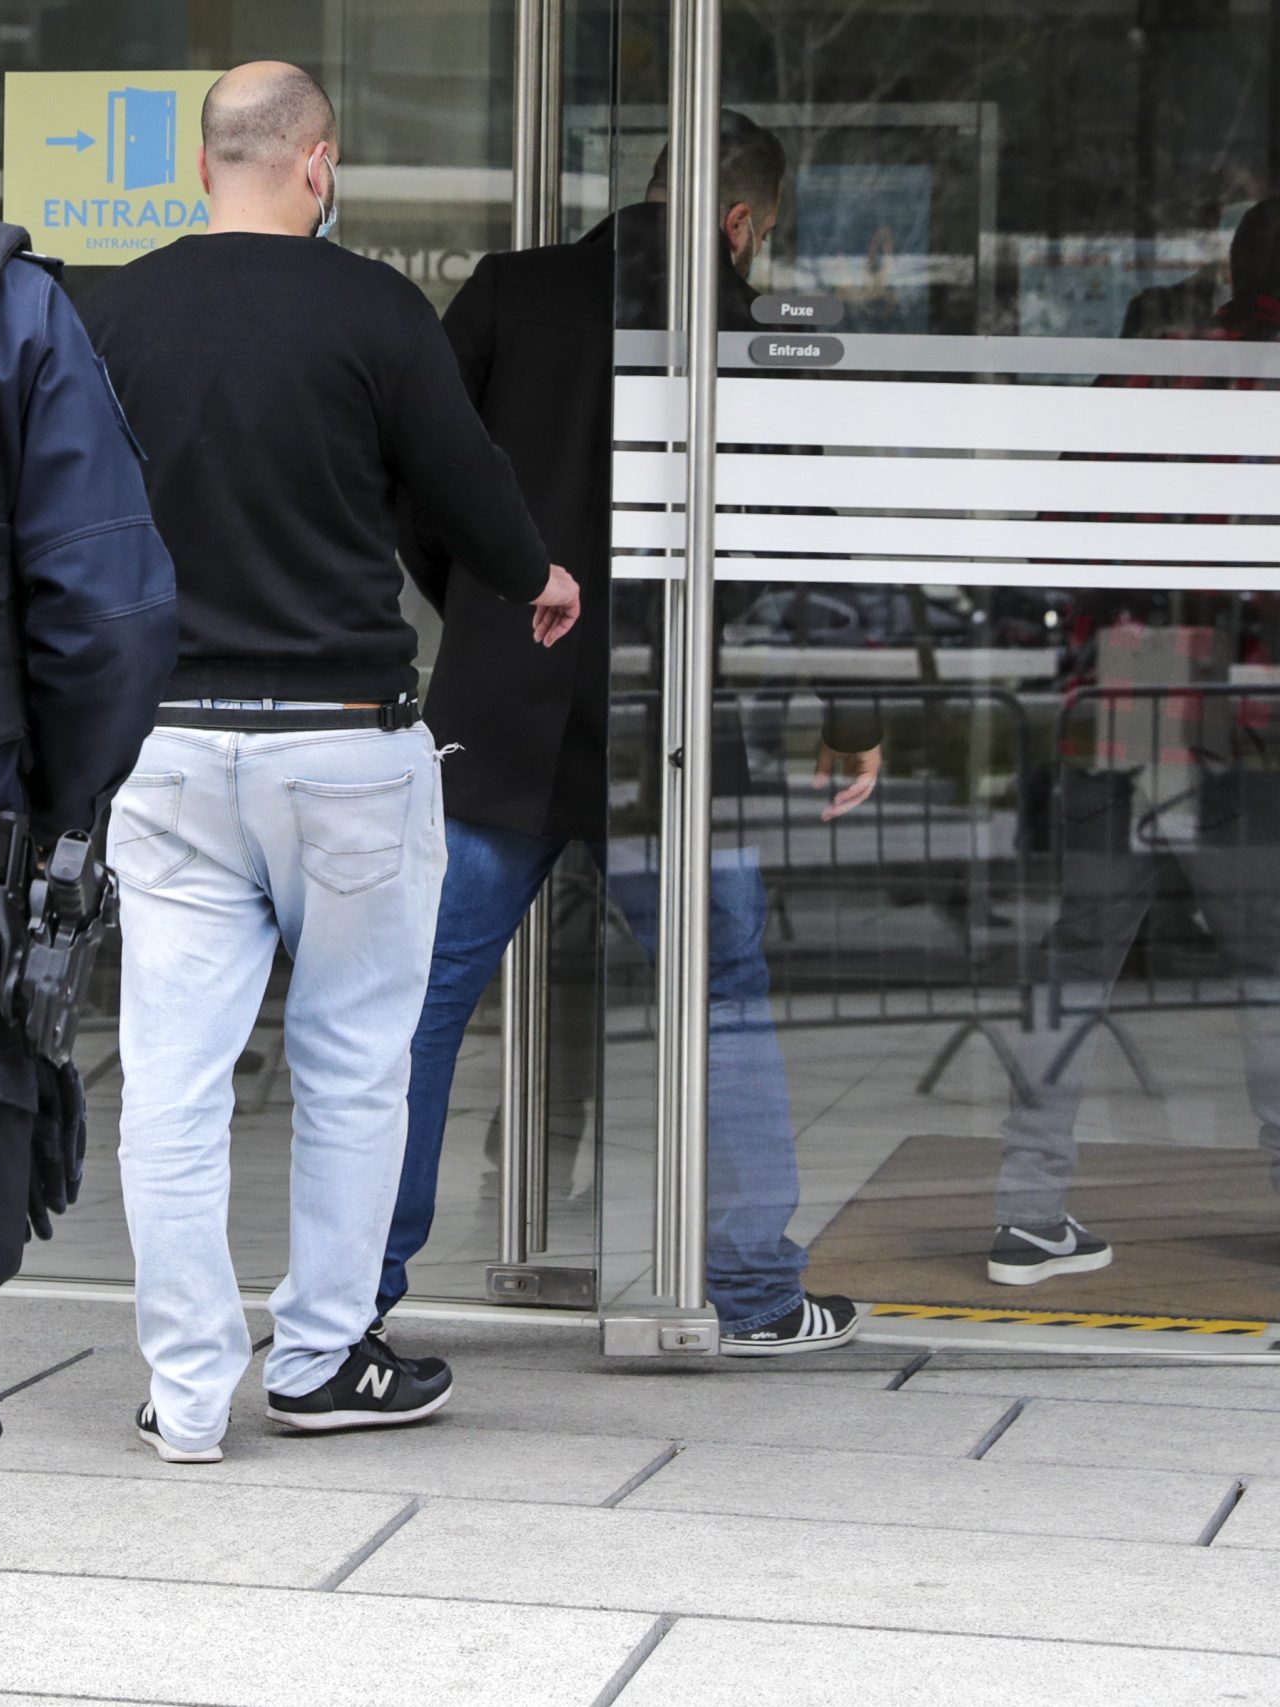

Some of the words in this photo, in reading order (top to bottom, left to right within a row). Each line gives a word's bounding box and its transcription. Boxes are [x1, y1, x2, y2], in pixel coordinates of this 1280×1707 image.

[43, 198, 210, 228] ENTRADA
[85, 237, 157, 250] ENTRANCE
[781, 303, 814, 317] Puxe
[768, 343, 821, 357] Entrada
